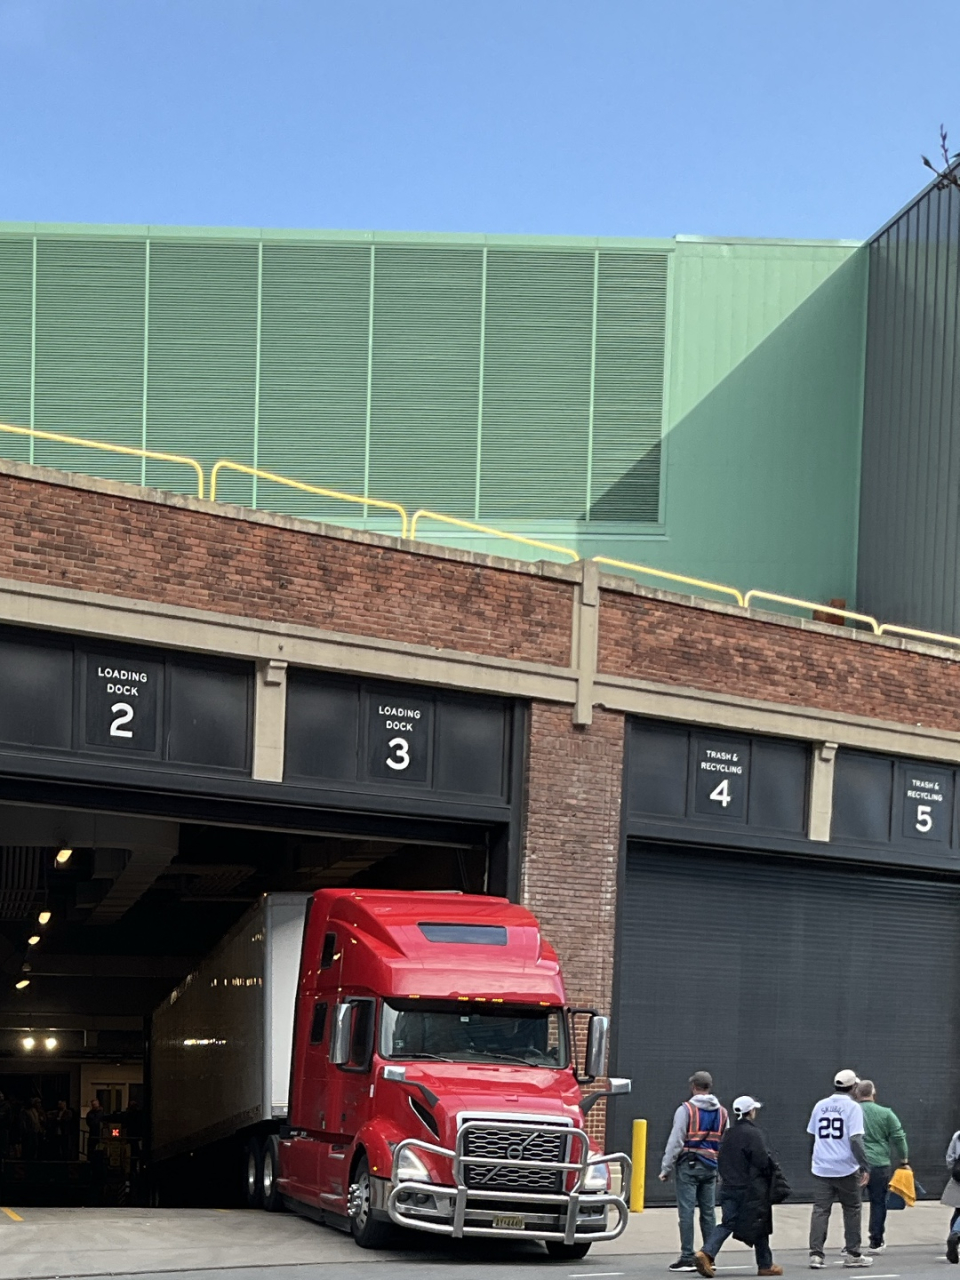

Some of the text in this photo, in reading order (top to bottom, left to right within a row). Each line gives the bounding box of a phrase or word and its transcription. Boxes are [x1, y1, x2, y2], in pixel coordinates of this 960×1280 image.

[98, 667, 147, 682] LOADING
[107, 683, 138, 696] DOCK
[378, 706, 421, 719] LOADING
[110, 702, 134, 738] 2
[386, 720, 413, 732] DOCK
[386, 737, 410, 770] 3
[706, 750, 739, 762] TRASH &
[701, 762, 742, 774] RECYCLING
[912, 779, 940, 790] TRASH &
[709, 779, 731, 807] 4
[907, 790, 943, 802] RECYCLING
[915, 805, 932, 832] 5
[818, 1117, 844, 1139] 29
